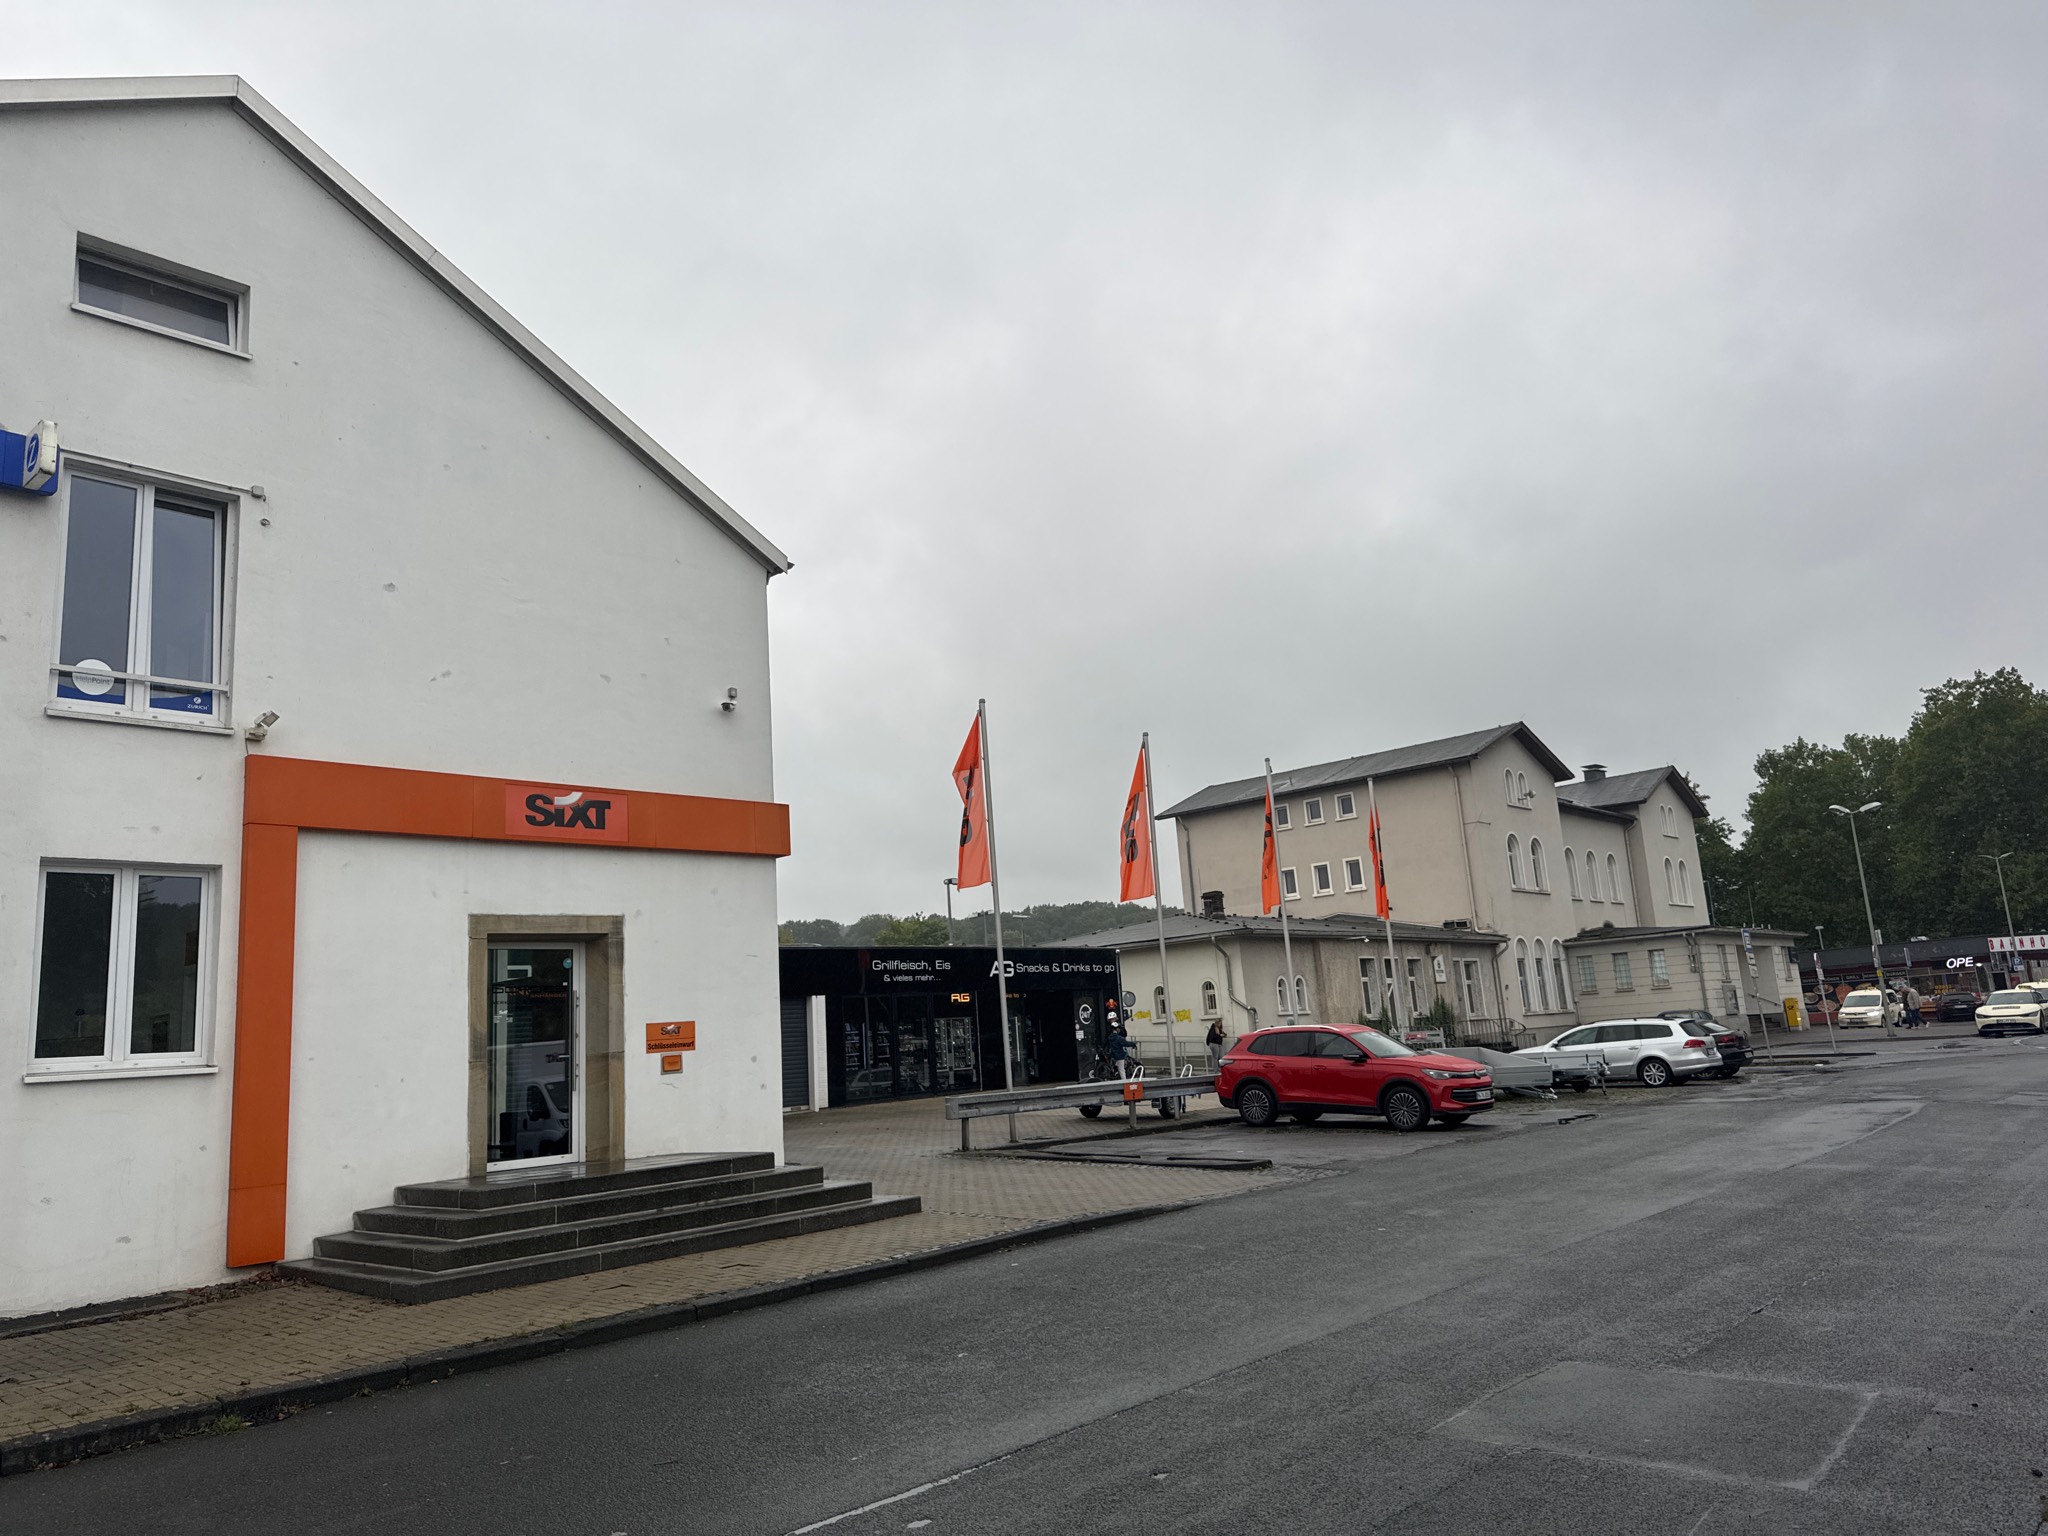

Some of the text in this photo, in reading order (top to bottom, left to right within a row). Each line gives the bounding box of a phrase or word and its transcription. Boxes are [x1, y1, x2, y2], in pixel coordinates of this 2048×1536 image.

[872, 960, 951, 971] Grillfleisch, Eis
[989, 960, 1015, 977] AG
[1016, 963, 1115, 973] Snacks & Drinks to go
[951, 993, 970, 1002] AG
